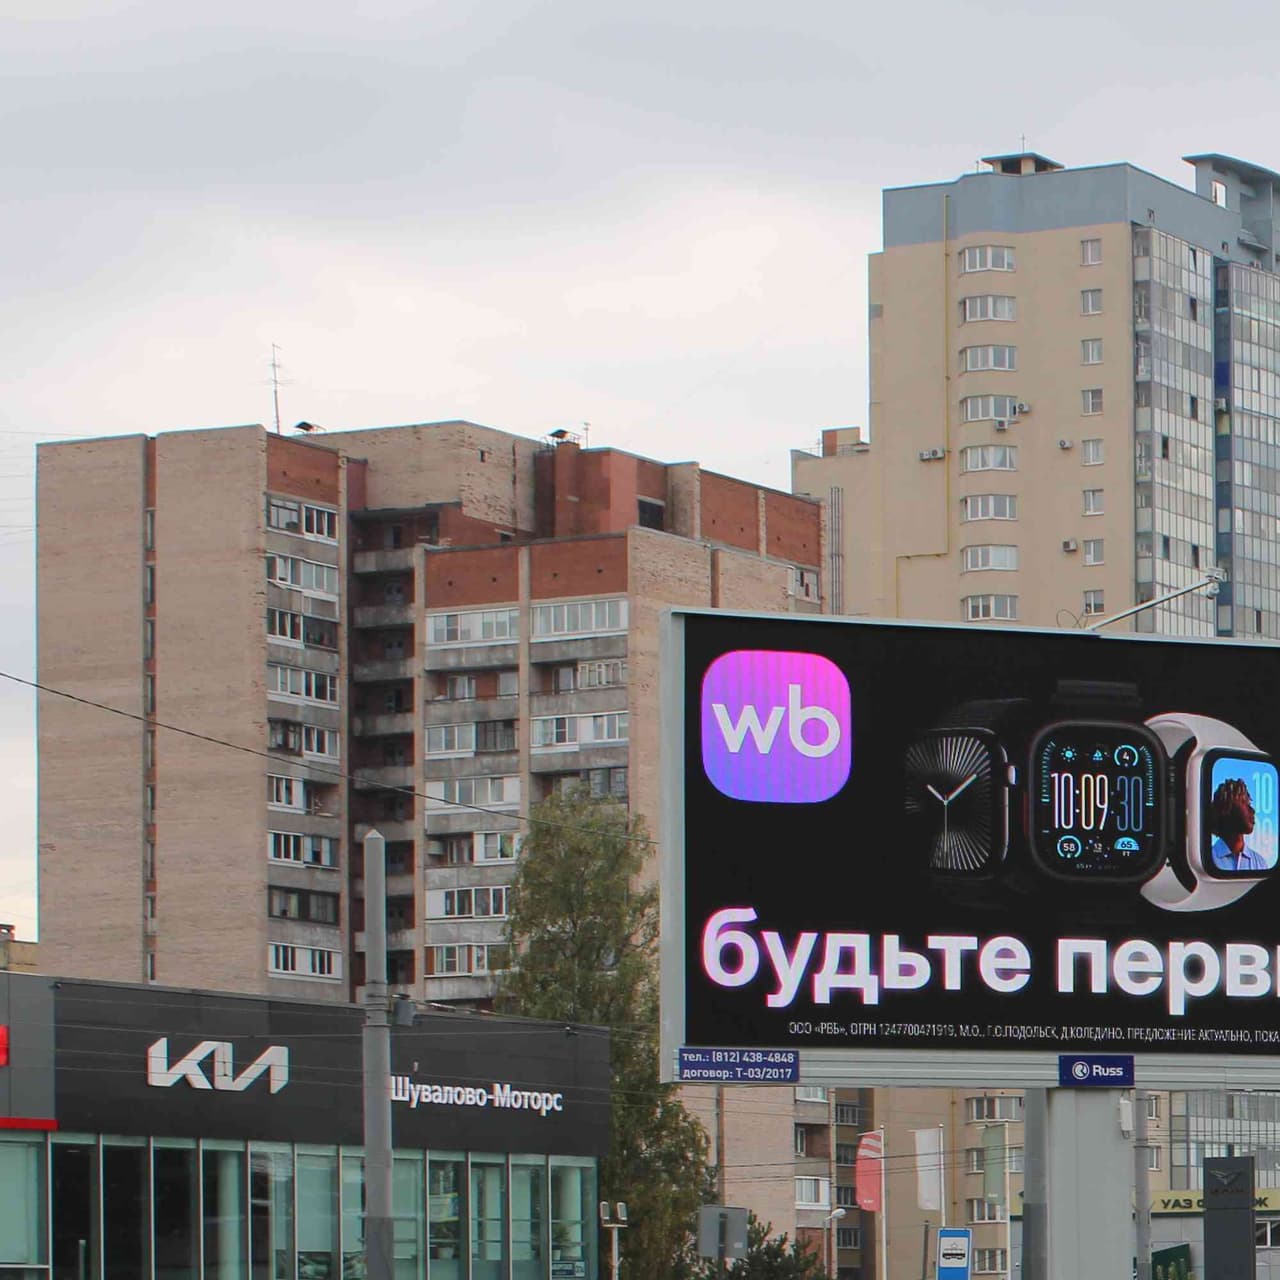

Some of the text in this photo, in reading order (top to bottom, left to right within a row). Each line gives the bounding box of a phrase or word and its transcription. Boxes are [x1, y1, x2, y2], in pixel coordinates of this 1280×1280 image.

[711, 683, 841, 758] wb
[1252, 771, 1273, 814] 10
[702, 906, 1032, 1008] будьте
[1255, 1030, 1280, 1043] ПОКА
[682, 1052, 709, 1062] тел.:
[742, 1052, 795, 1064] 438-4848
[682, 1068, 733, 1080] договор:
[1092, 1064, 1124, 1077] Russ
[390, 1075, 563, 1117] Шувалово-Моторс
[1160, 1197, 1193, 1210] УАЗ
